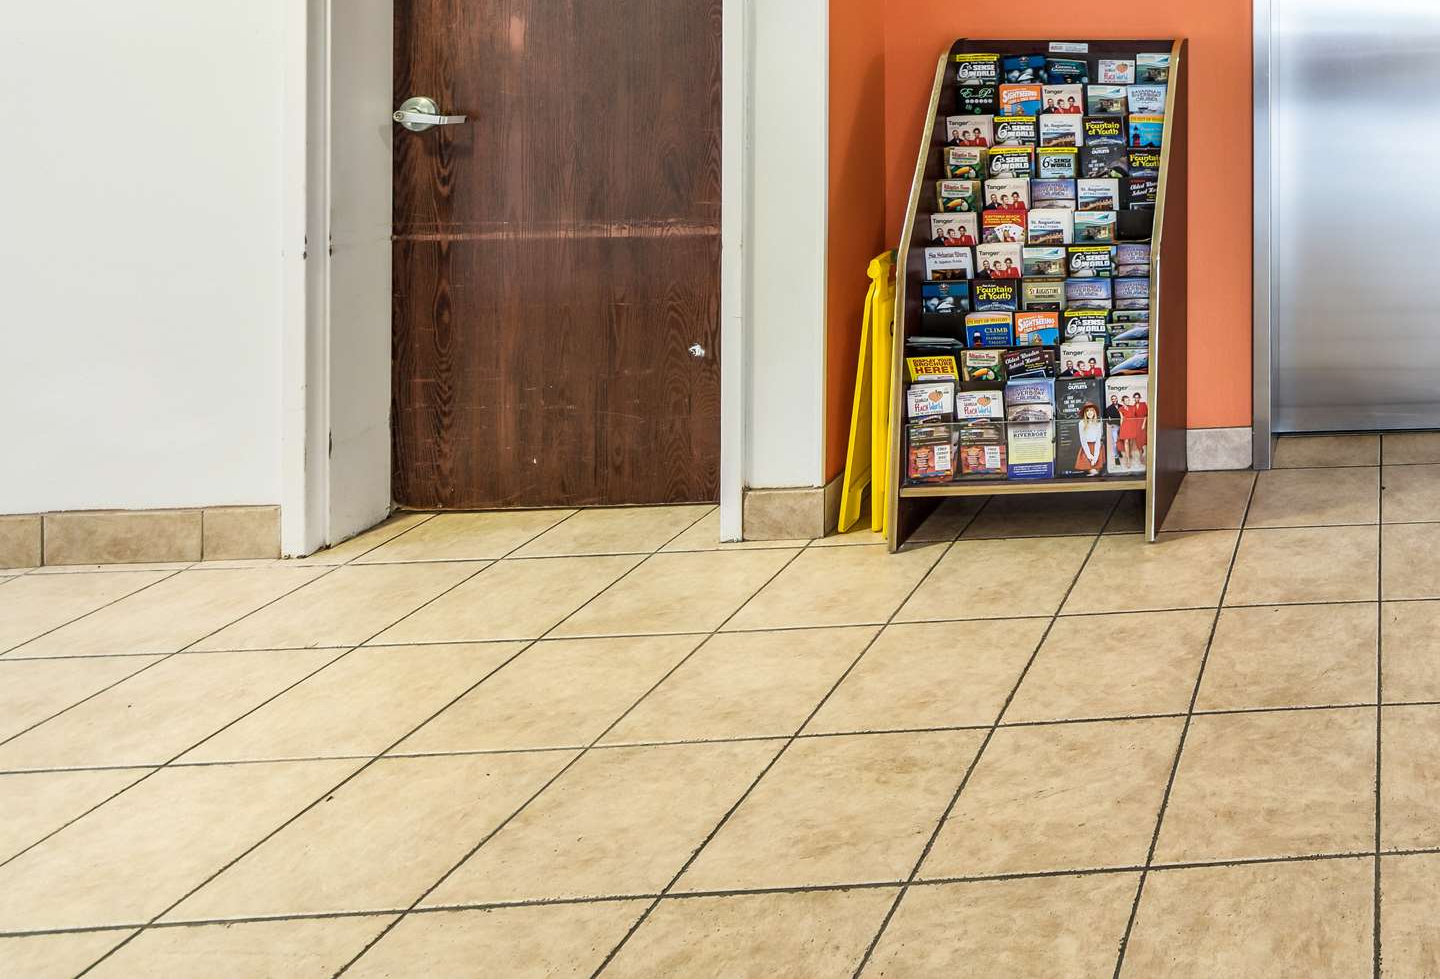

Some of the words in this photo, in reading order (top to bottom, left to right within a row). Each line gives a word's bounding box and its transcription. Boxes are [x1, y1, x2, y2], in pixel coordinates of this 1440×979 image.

[976, 286, 1013, 294] Fountain
[987, 292, 1011, 300] Youth
[915, 366, 954, 374] HERE!
